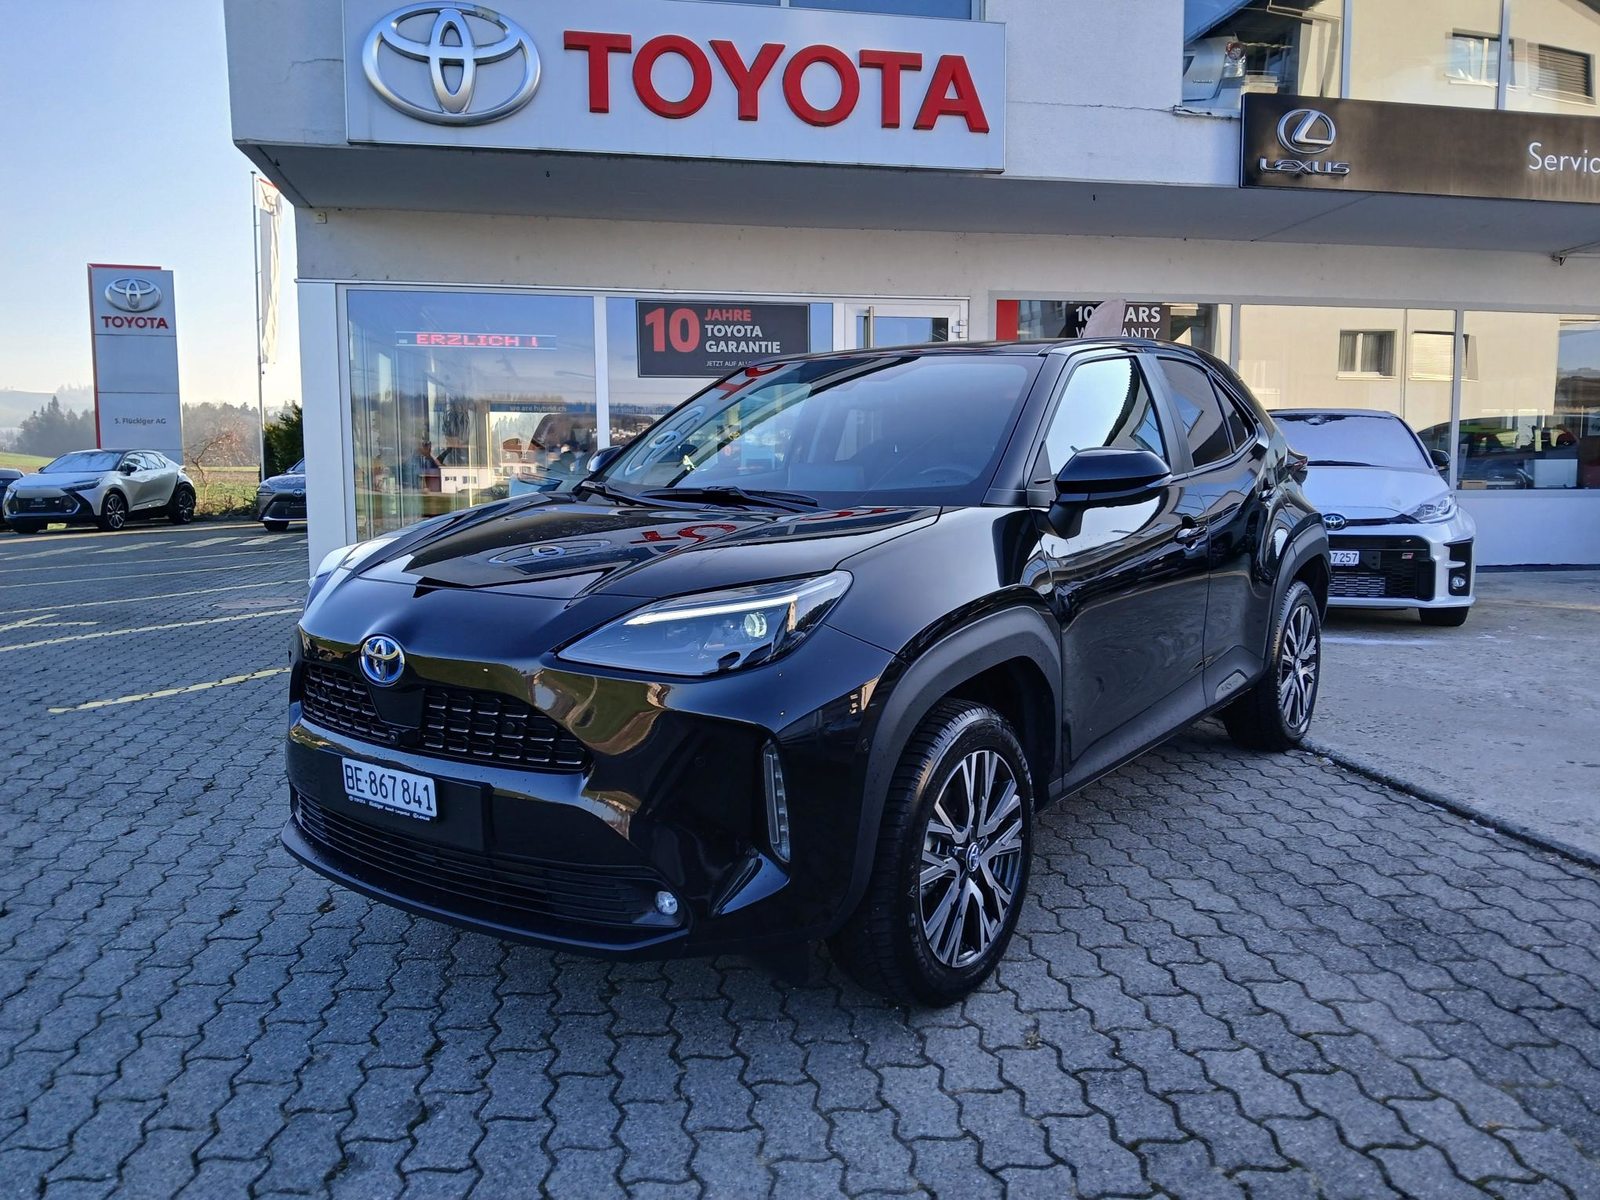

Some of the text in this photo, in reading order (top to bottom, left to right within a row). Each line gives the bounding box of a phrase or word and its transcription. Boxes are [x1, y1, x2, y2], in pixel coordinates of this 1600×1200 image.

[563, 30, 990, 133] TOYOTA
[1259, 157, 1350, 175] LEXUS
[705, 308, 752, 322] JAHRE
[1124, 306, 1161, 323] ARS
[101, 315, 169, 329] TOYOTA
[645, 307, 700, 353] 10
[705, 324, 763, 338] TOYOTA
[416, 333, 520, 347] ERZLICH
[705, 340, 781, 353] GARANTIE
[155, 417, 167, 425] AG
